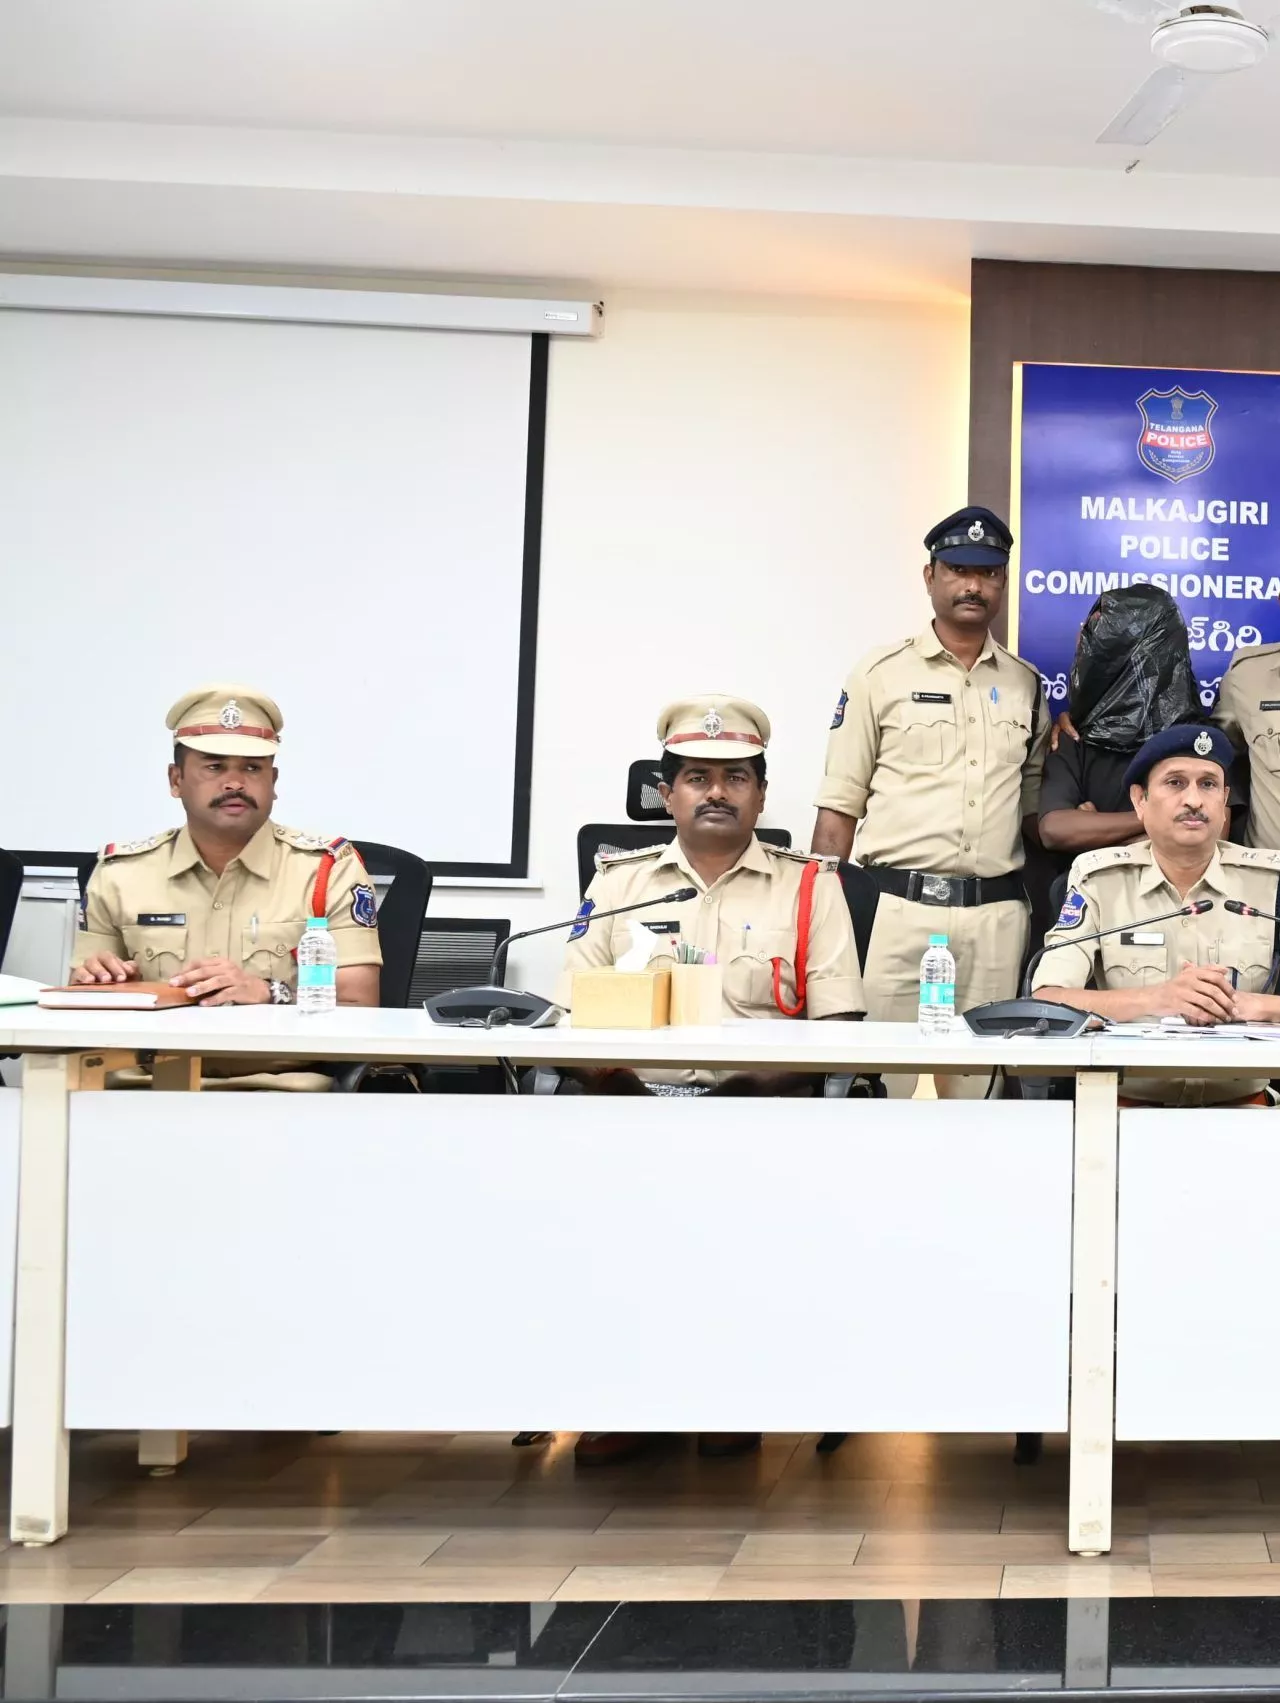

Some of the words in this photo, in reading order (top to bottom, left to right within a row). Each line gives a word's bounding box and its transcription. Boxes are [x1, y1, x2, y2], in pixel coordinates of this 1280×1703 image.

[1150, 422, 1204, 433] TELANGANA
[1146, 432, 1208, 448] POLICE
[1081, 496, 1268, 525] MALKAJGIRI
[1120, 535, 1230, 561] POLICE
